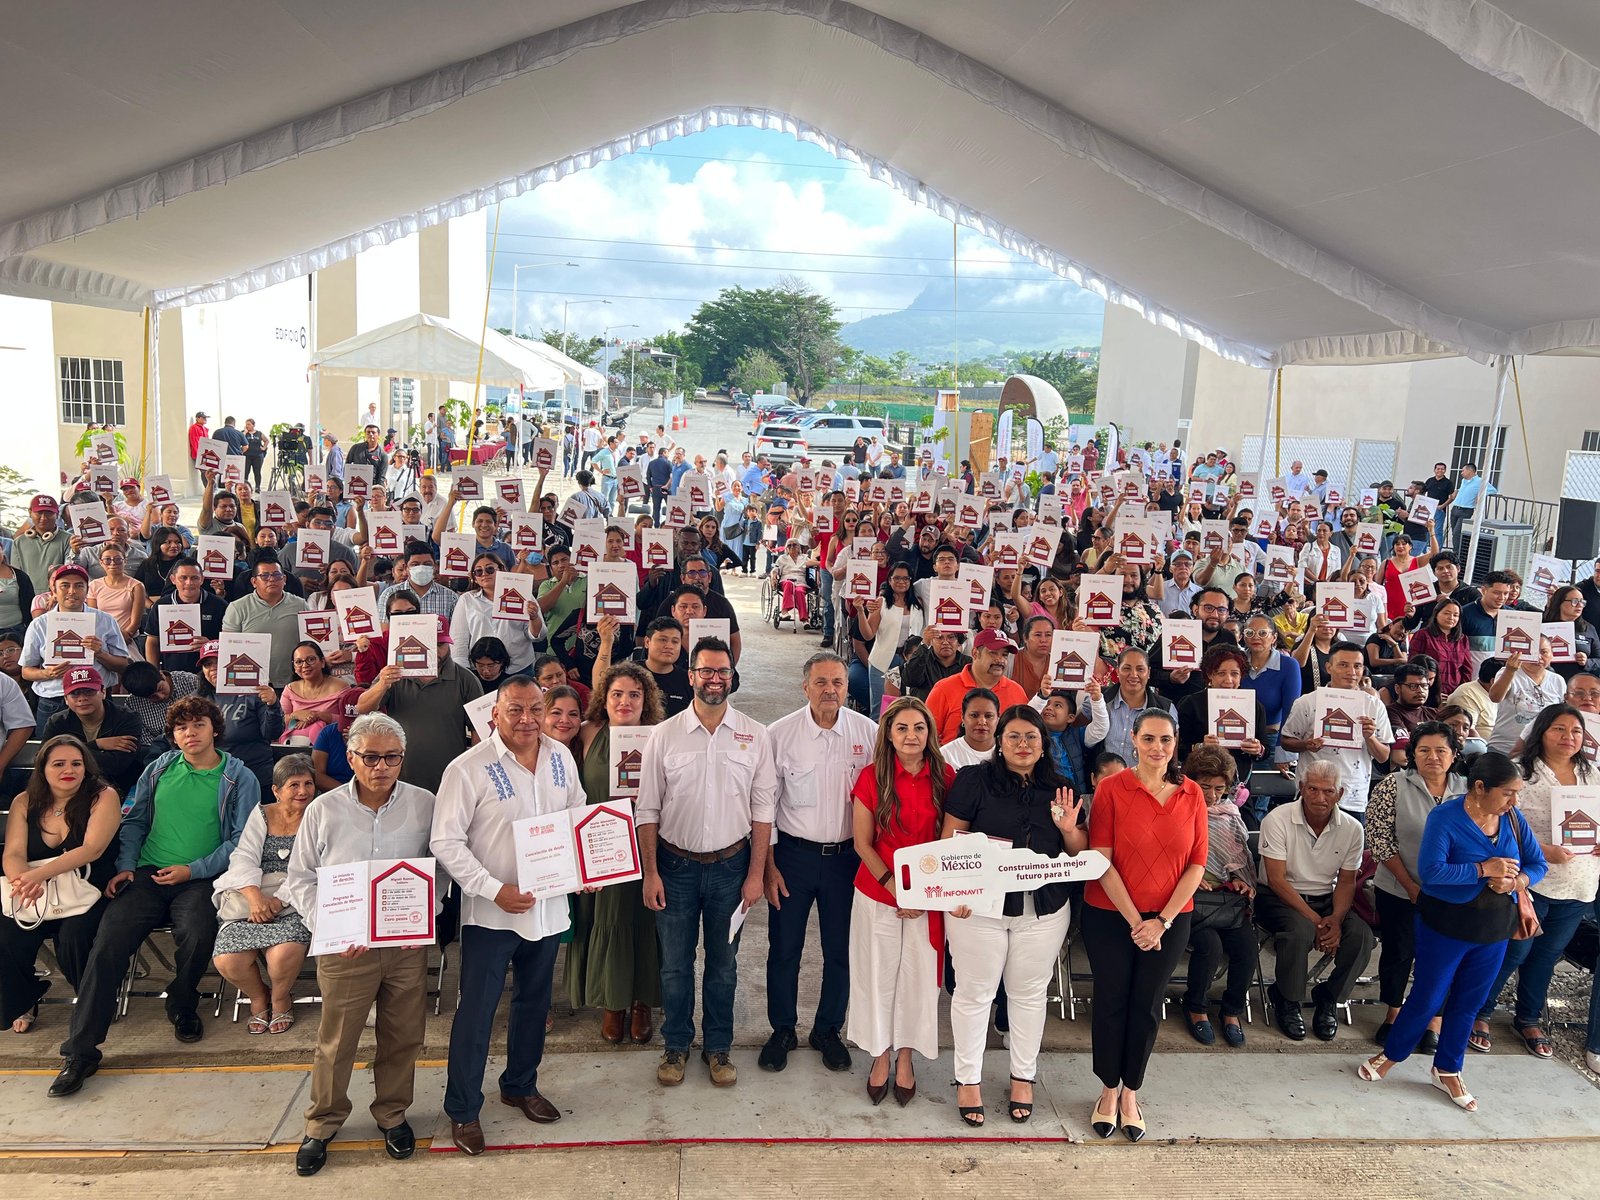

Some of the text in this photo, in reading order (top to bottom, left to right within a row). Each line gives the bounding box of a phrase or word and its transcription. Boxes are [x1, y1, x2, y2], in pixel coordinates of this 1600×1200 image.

[300, 326, 306, 349] 6
[941, 859, 982, 872] México
[998, 862, 1049, 872] Construimos
[1063, 859, 1087, 869] mejor
[1044, 872, 1062, 880] para
[943, 888, 984, 897] INFONAVIT
